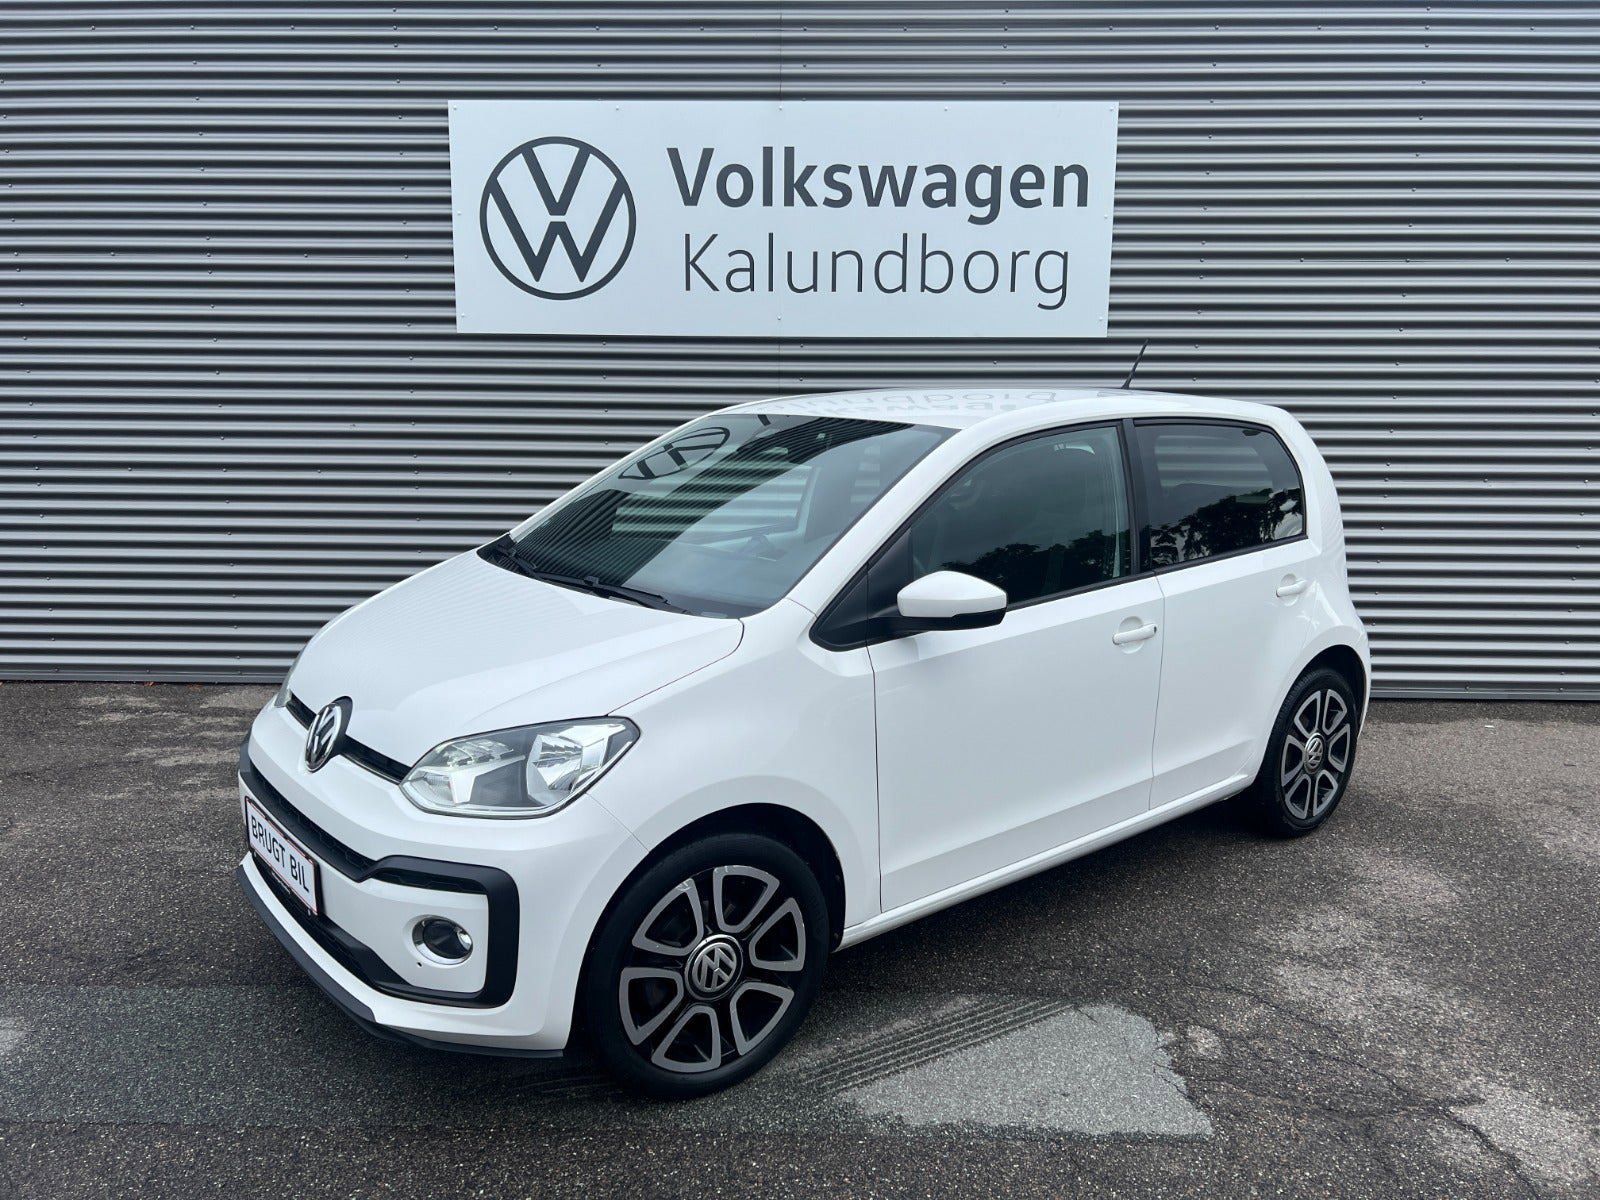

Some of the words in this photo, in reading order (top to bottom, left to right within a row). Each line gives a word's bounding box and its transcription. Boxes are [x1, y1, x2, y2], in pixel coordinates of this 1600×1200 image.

[667, 146, 1089, 225] Volkswagen
[685, 232, 1069, 310] Kalundborg
[251, 815, 286, 868] BRUGT
[289, 854, 310, 893] BIL
